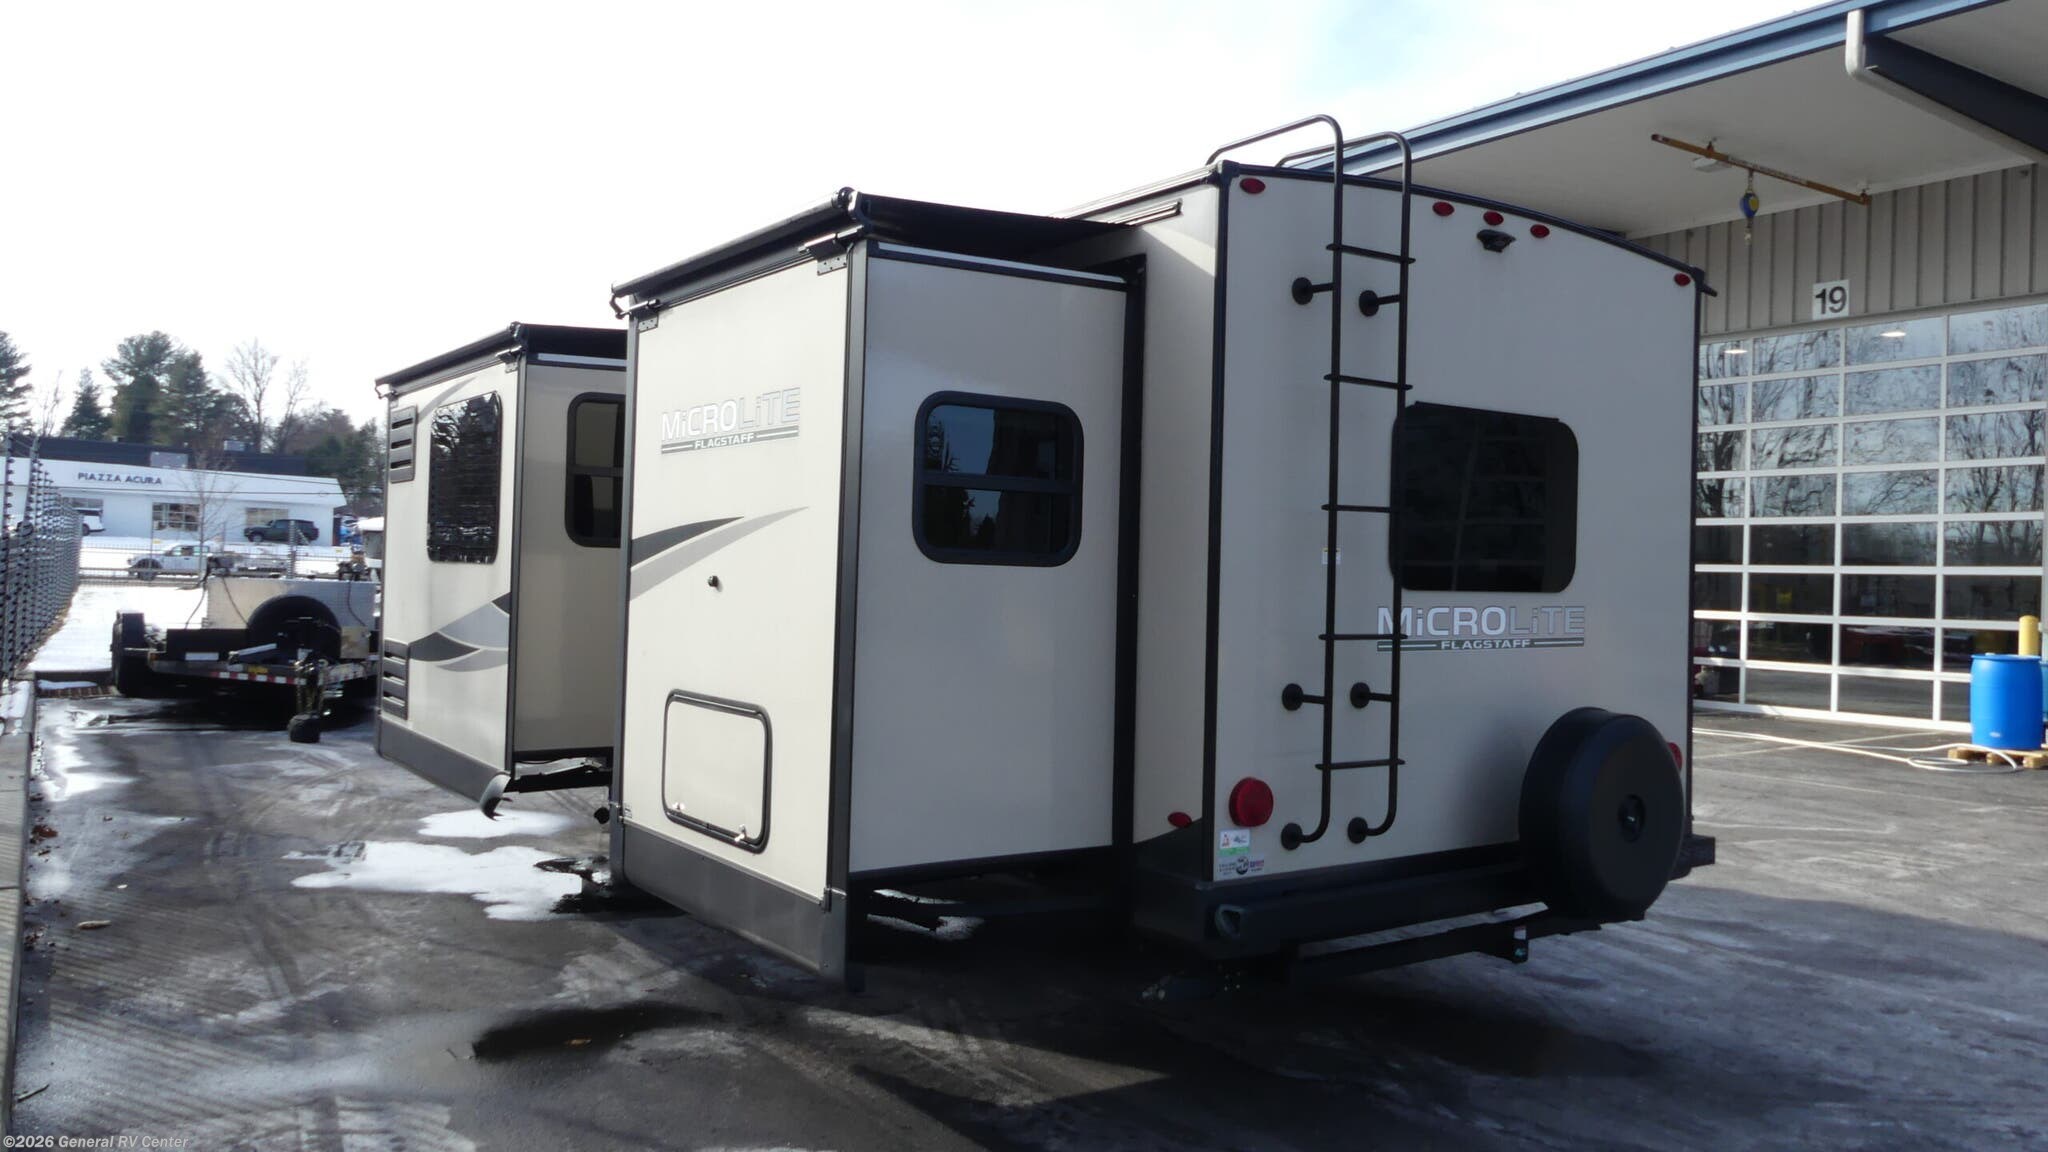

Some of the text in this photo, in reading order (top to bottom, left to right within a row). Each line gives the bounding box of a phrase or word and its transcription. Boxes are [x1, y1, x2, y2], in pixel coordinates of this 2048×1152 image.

[1815, 286, 1847, 315] 19
[694, 432, 755, 450] FLAGSTAFF
[77, 472, 162, 485] PIAZZA ACURA
[1440, 638, 1532, 650] FLAGSTAFF
